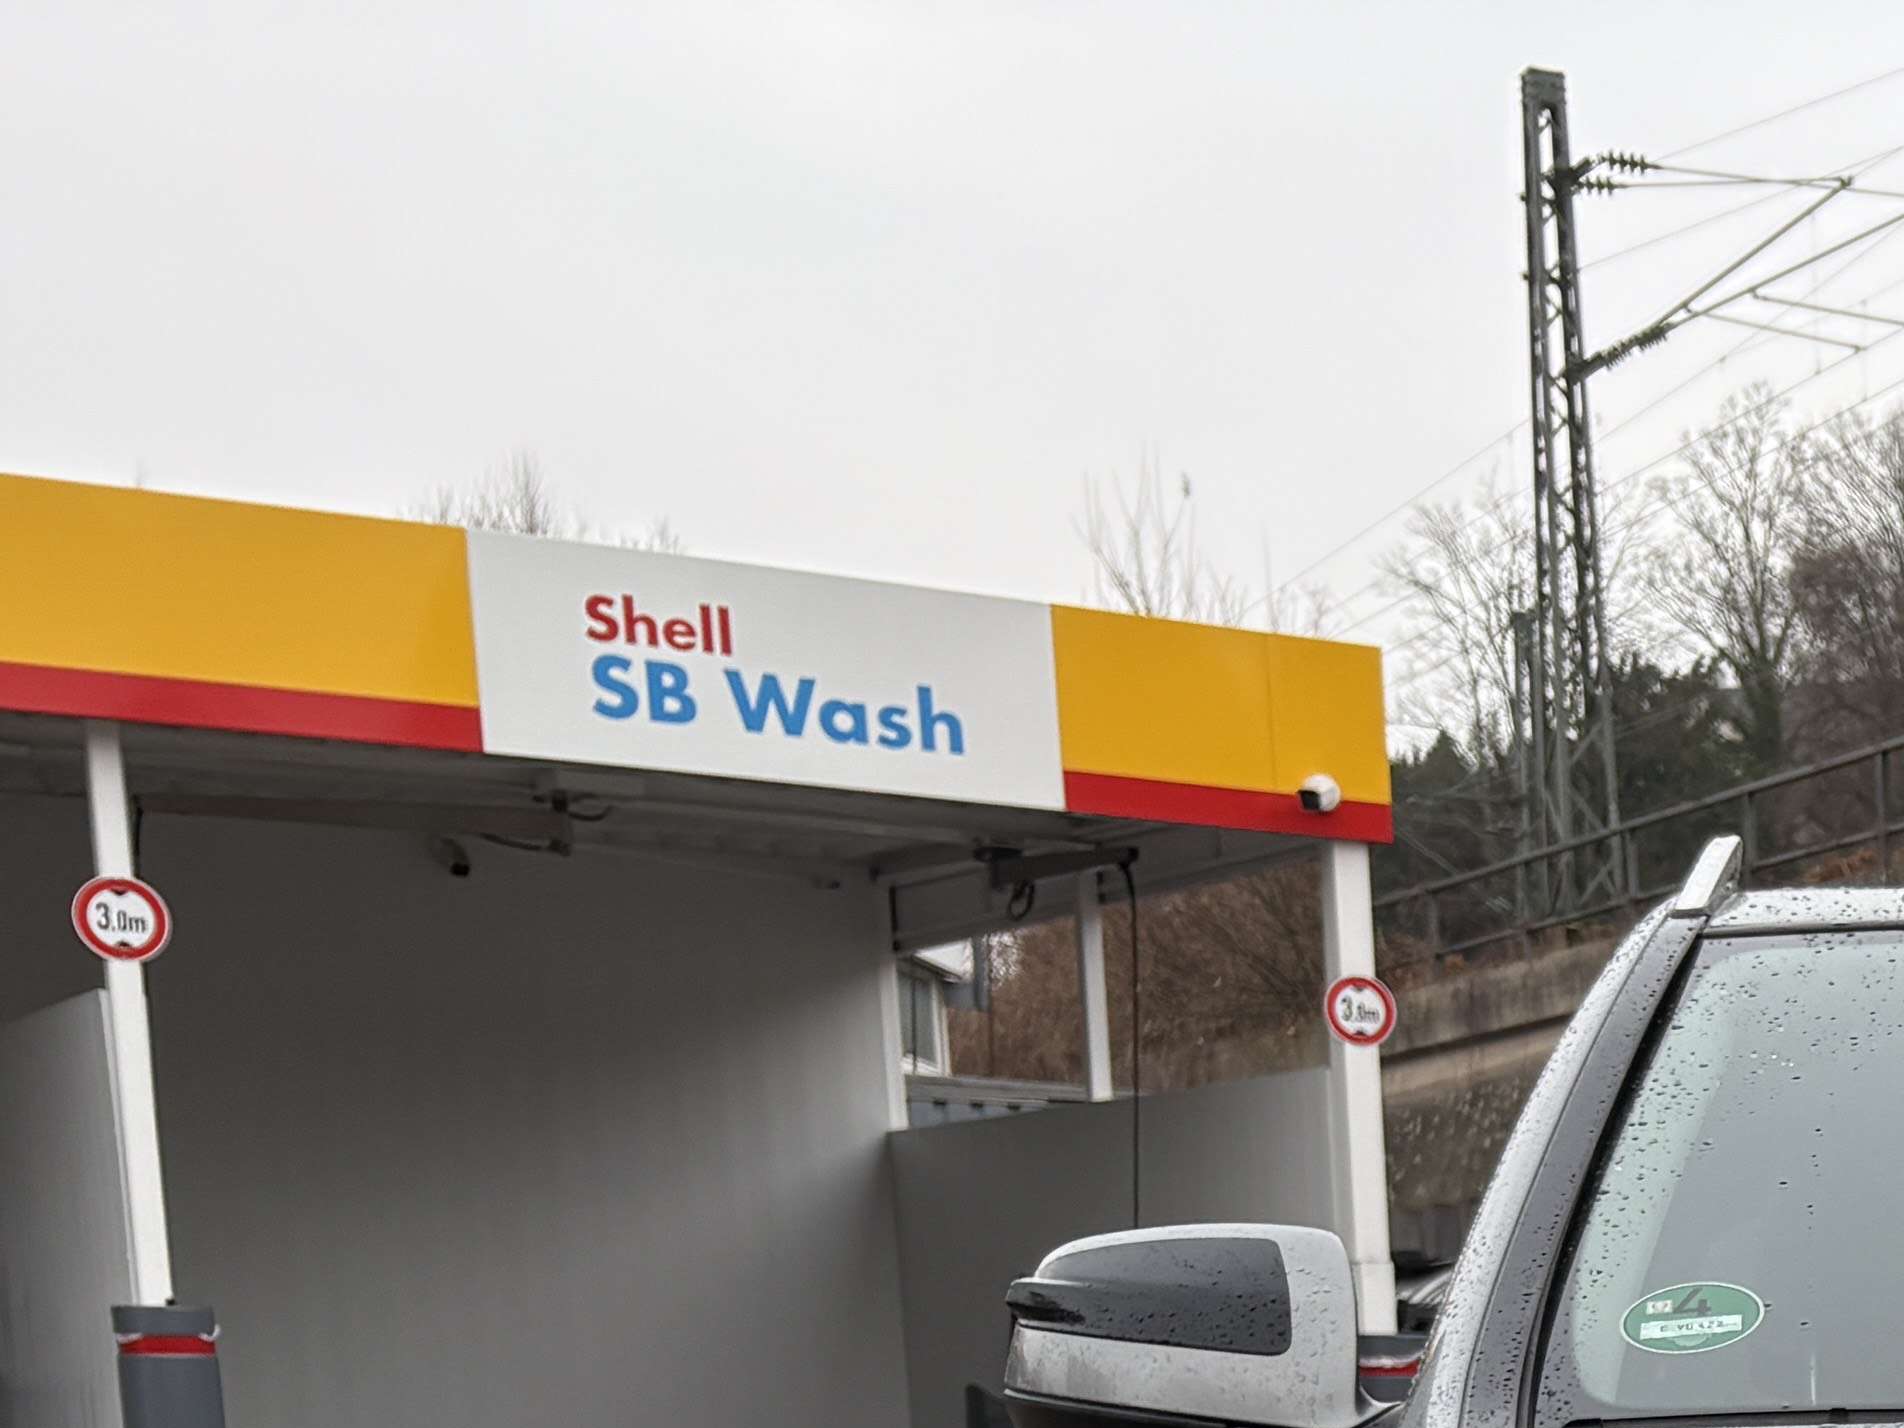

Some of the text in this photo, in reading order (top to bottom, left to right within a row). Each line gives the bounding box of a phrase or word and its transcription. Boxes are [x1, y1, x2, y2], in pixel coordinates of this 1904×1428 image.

[584, 594, 733, 656] Shell
[591, 654, 964, 756] SB Wash
[1673, 1287, 1712, 1316] 4
